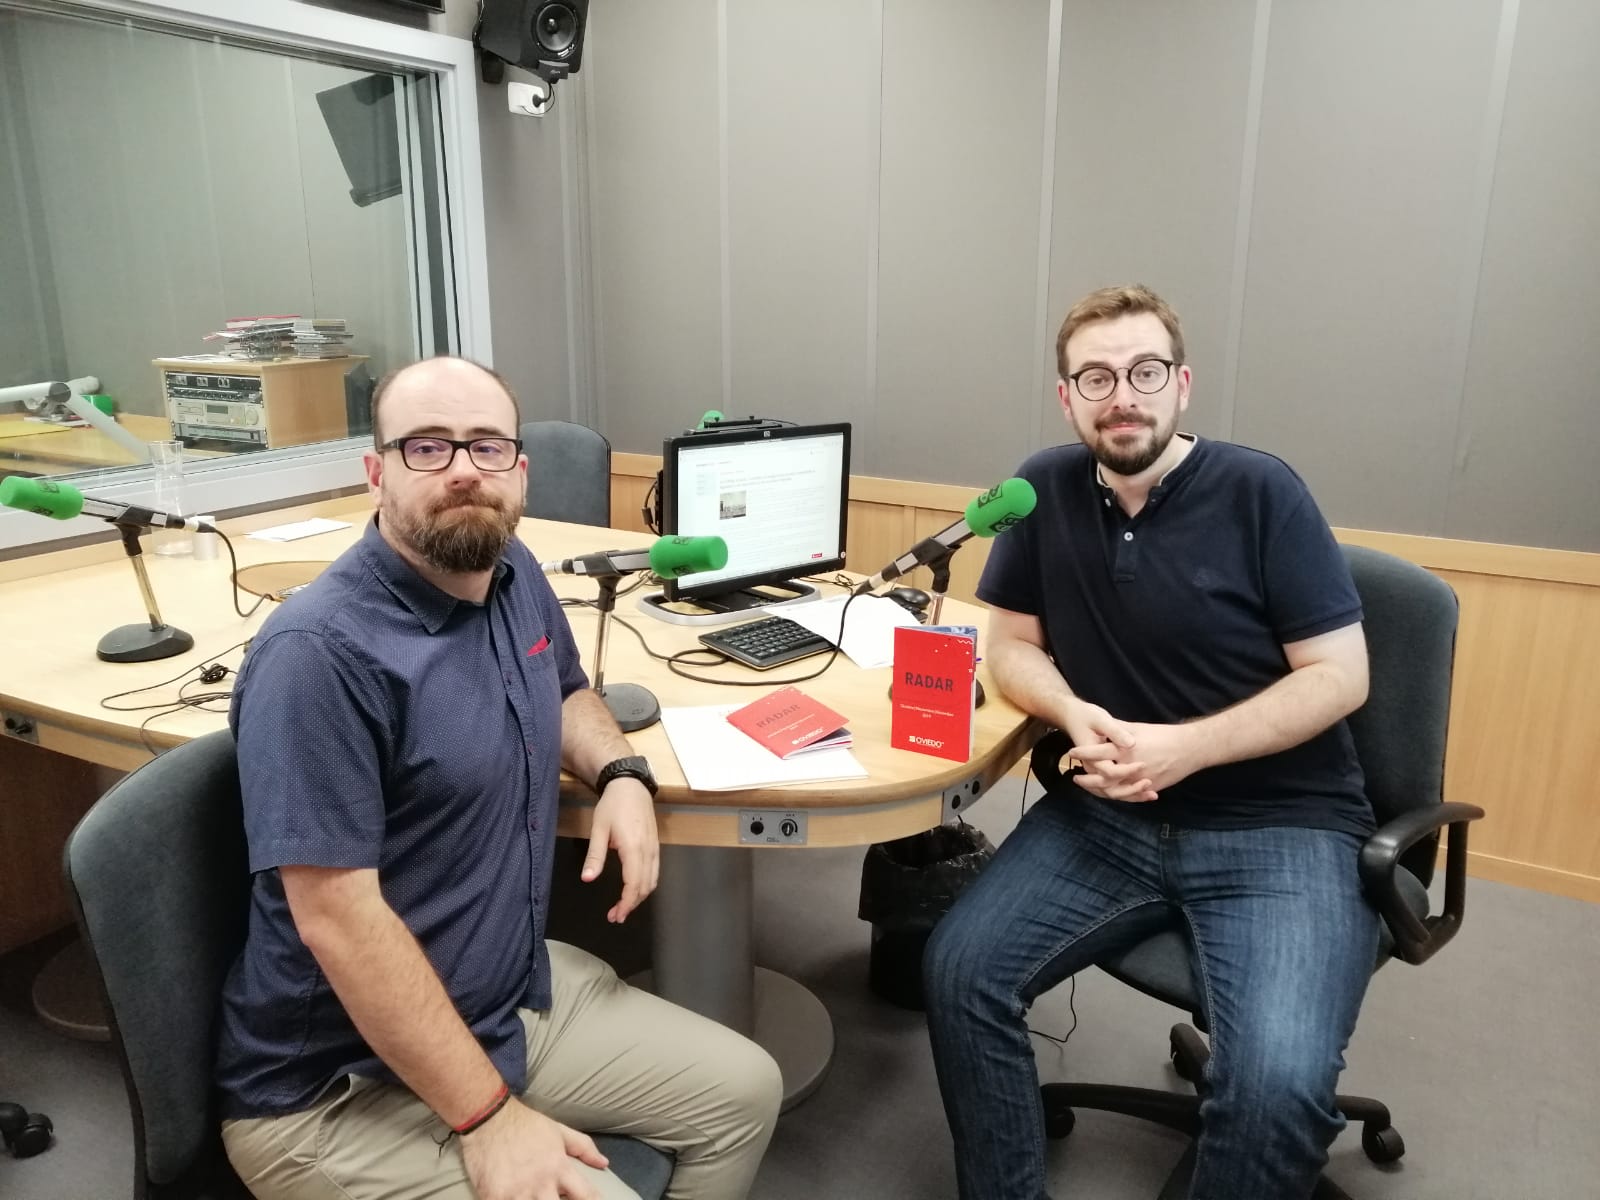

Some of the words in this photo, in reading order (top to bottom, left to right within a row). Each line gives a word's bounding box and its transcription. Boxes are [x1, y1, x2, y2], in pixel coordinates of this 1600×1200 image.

[905, 671, 954, 692] RADAR
[756, 703, 801, 728] RADAR
[915, 736, 943, 749] OVIEDO
